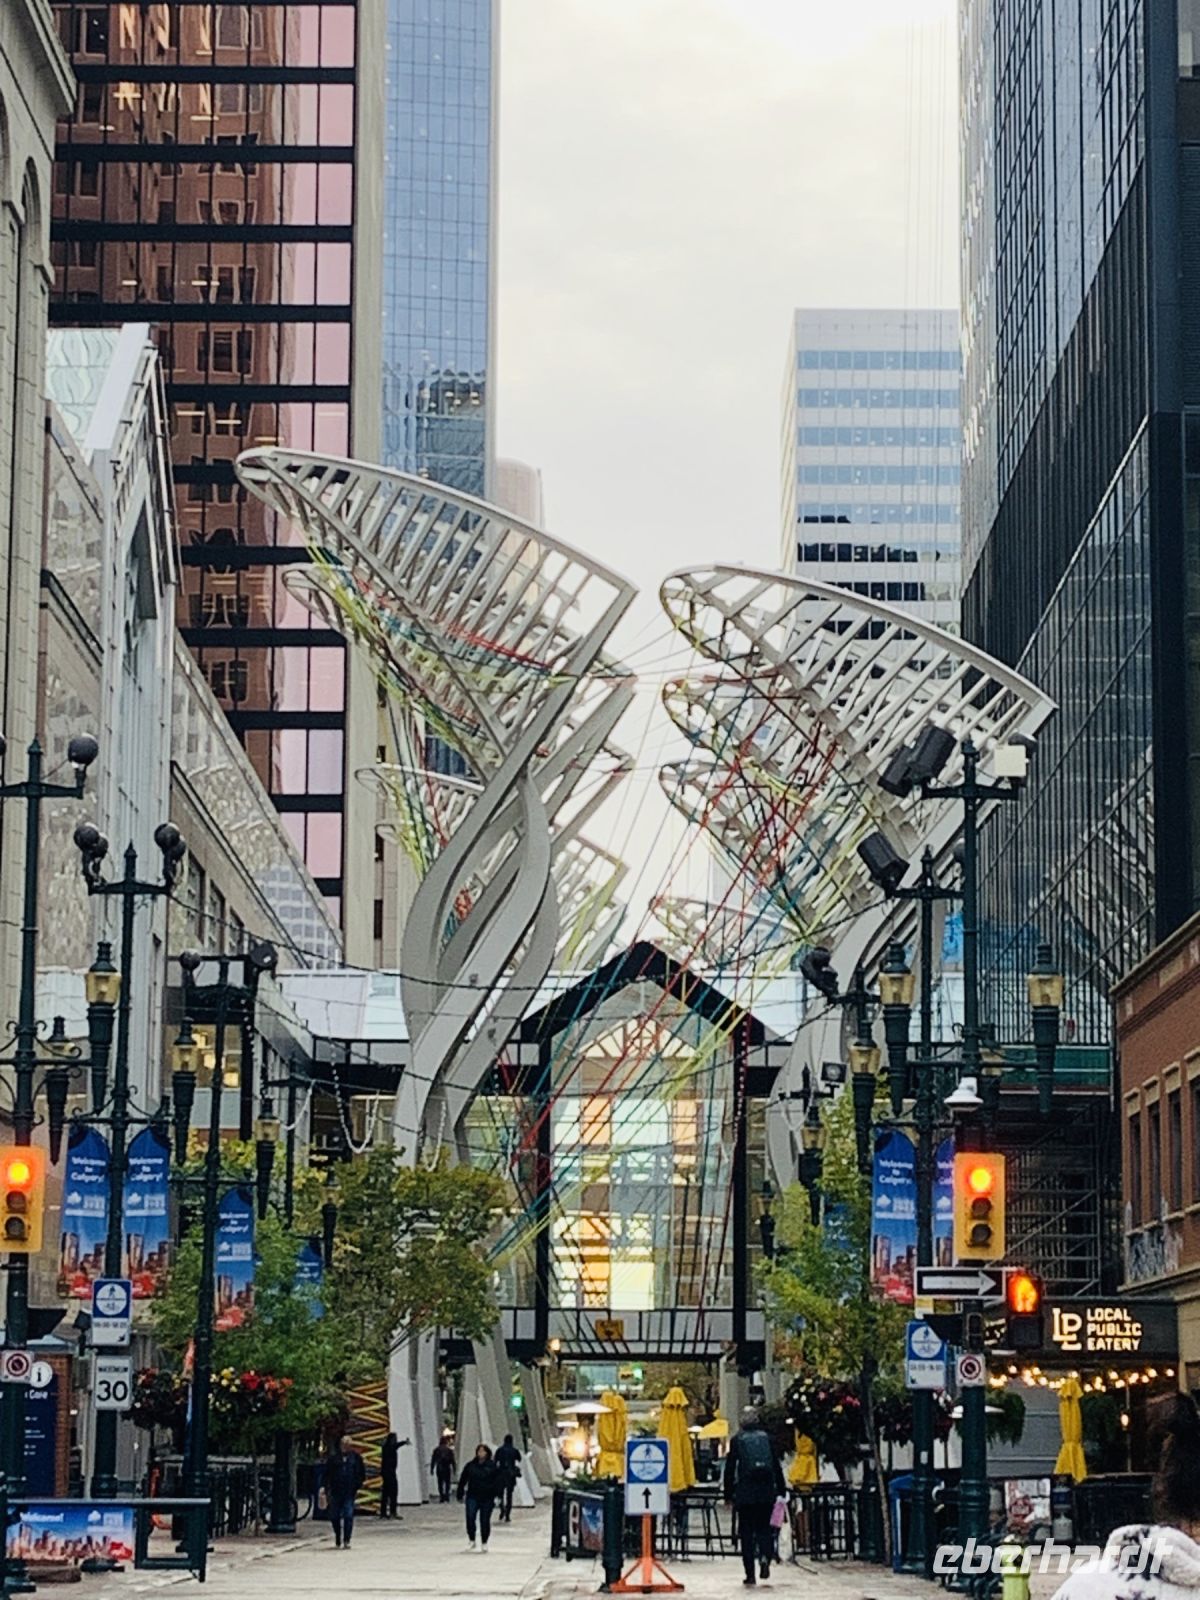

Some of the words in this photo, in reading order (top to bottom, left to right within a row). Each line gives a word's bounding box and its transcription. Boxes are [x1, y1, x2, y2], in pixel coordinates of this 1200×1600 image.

[1086, 1307, 1132, 1322] LOCAL
[1086, 1322, 1142, 1337] PUBLIC
[1087, 1337, 1140, 1351] EATERY
[97, 1381, 128, 1402] 30
